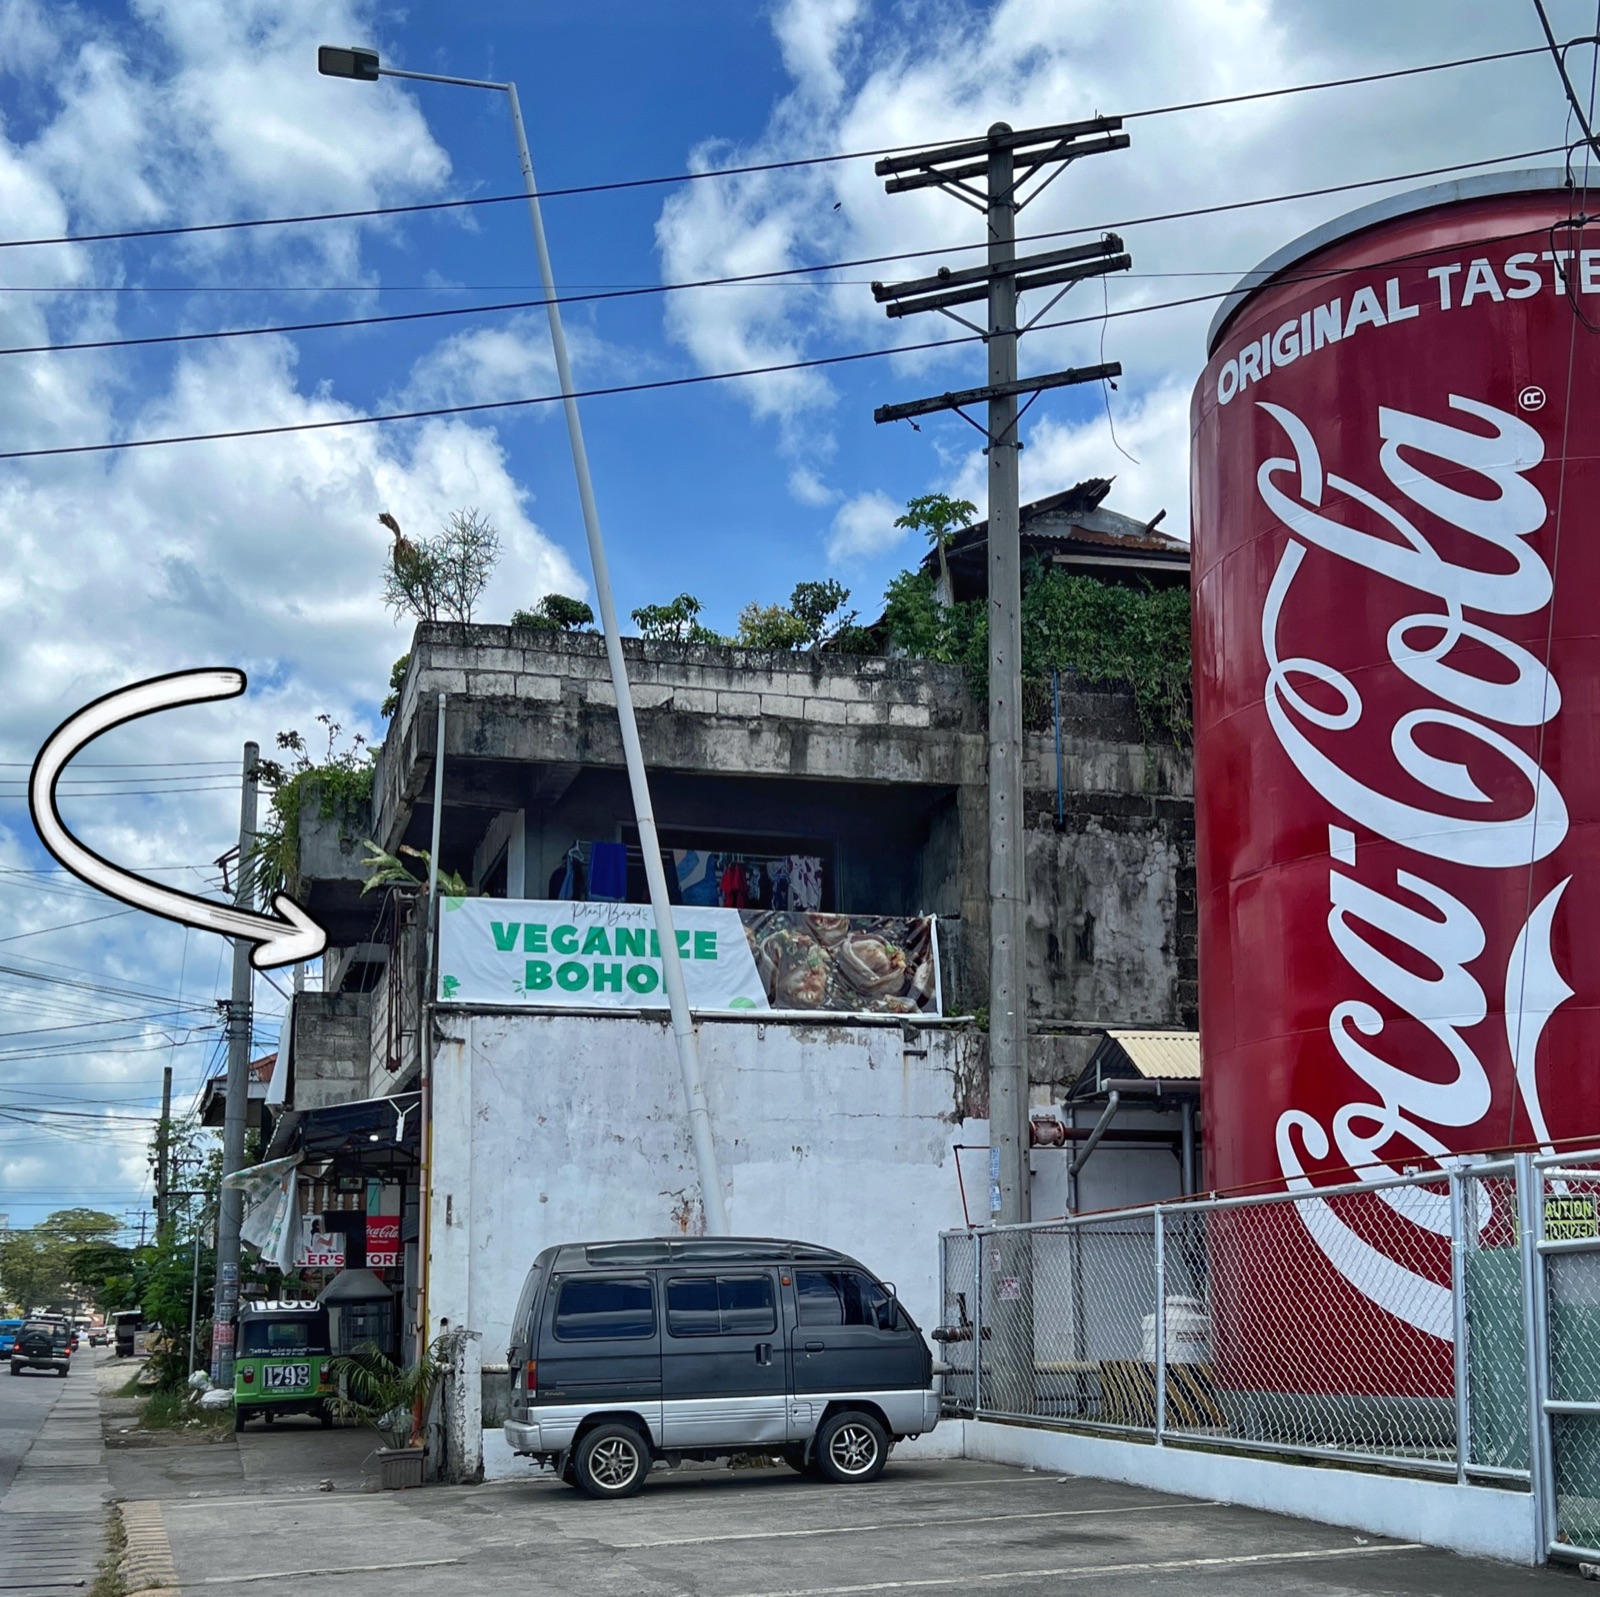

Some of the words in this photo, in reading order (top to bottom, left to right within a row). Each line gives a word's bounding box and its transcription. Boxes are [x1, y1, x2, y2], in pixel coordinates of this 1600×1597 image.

[1217, 277, 1420, 405] ORIGINAL
[1428, 249, 1600, 311] TASTE
[1254, 393, 1570, 1342] Coca-Cola
[571, 902, 603, 924] Plant
[490, 921, 718, 960] VEGANIZE
[1545, 1200, 1593, 1218] AUTION
[1545, 1223, 1594, 1239] HORIZED
[296, 1254, 345, 1266] LER'S
[267, 1366, 309, 1386] 1798
